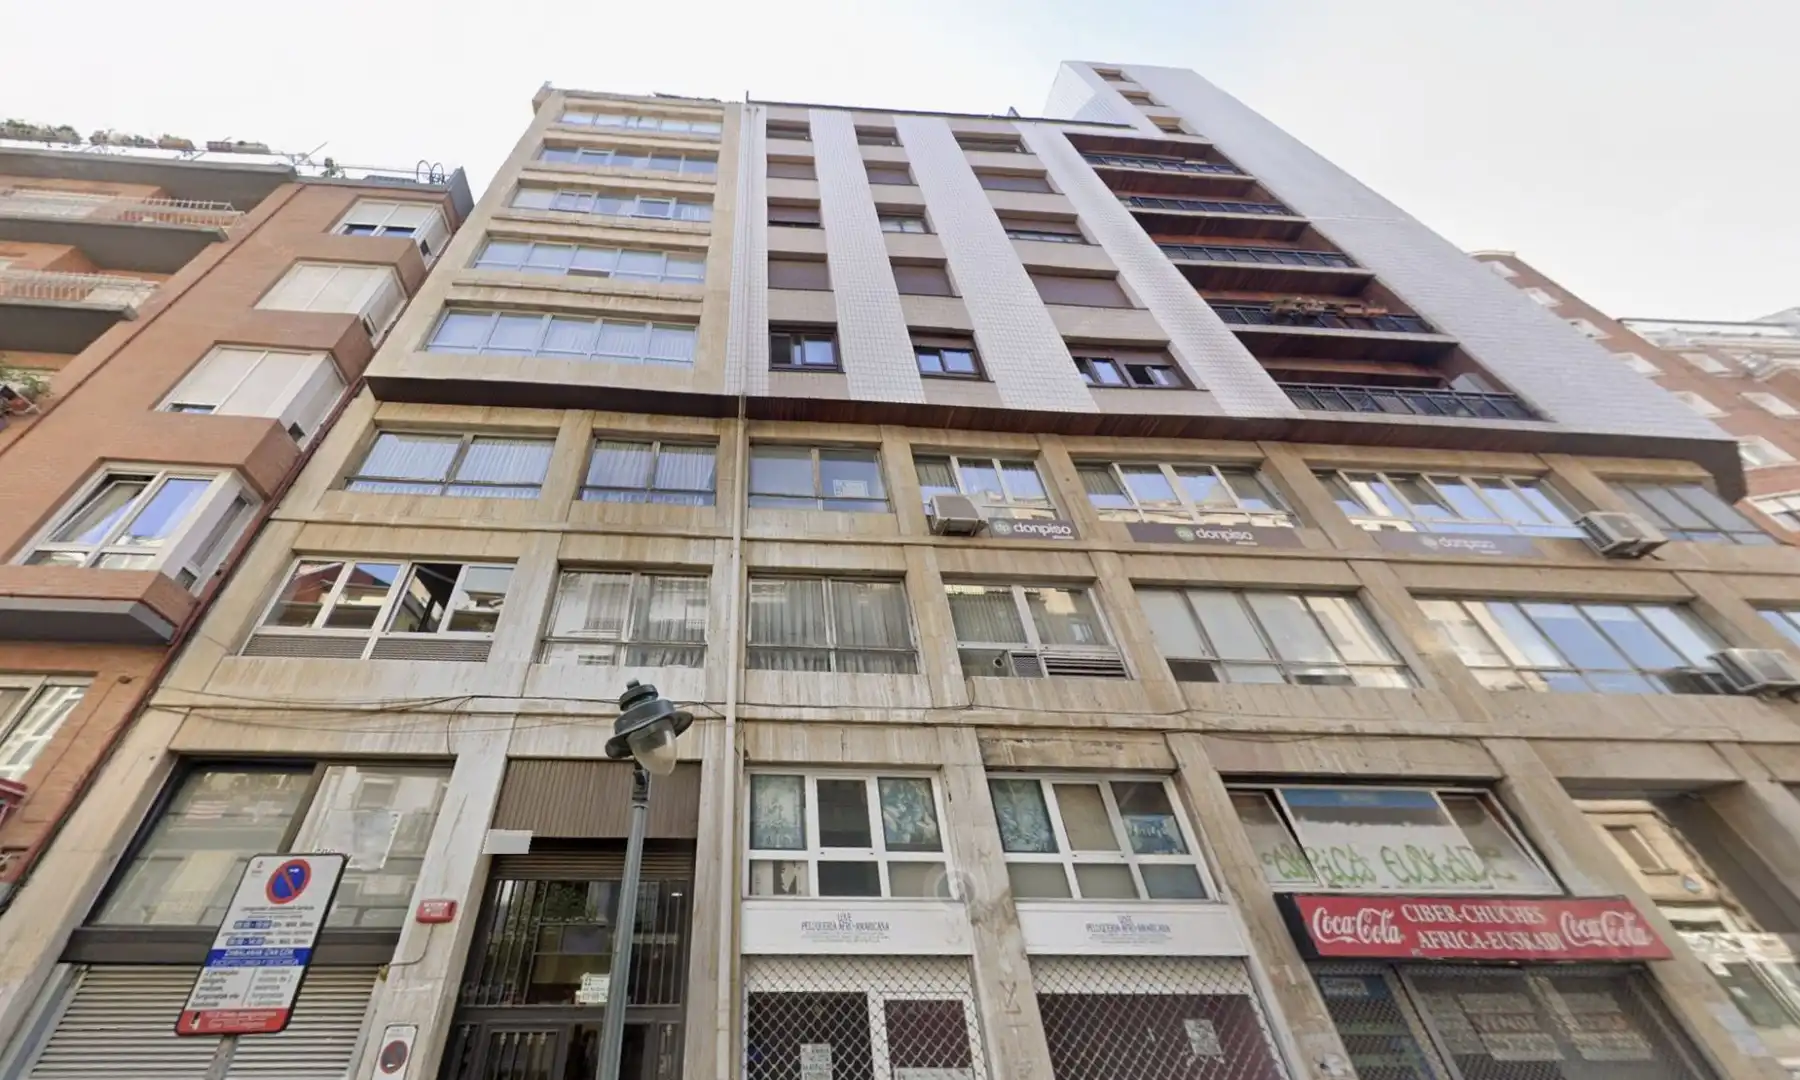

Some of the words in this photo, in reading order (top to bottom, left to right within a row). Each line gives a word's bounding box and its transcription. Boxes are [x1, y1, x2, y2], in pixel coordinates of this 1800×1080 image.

[1013, 522, 1071, 536] donpiso
[1195, 528, 1253, 542] donpiso
[1312, 906, 1402, 944] Coca-Cola
[1401, 903, 1547, 926] CIBER-CHUCHES
[1416, 930, 1567, 951] AFRICA-EUSKADI
